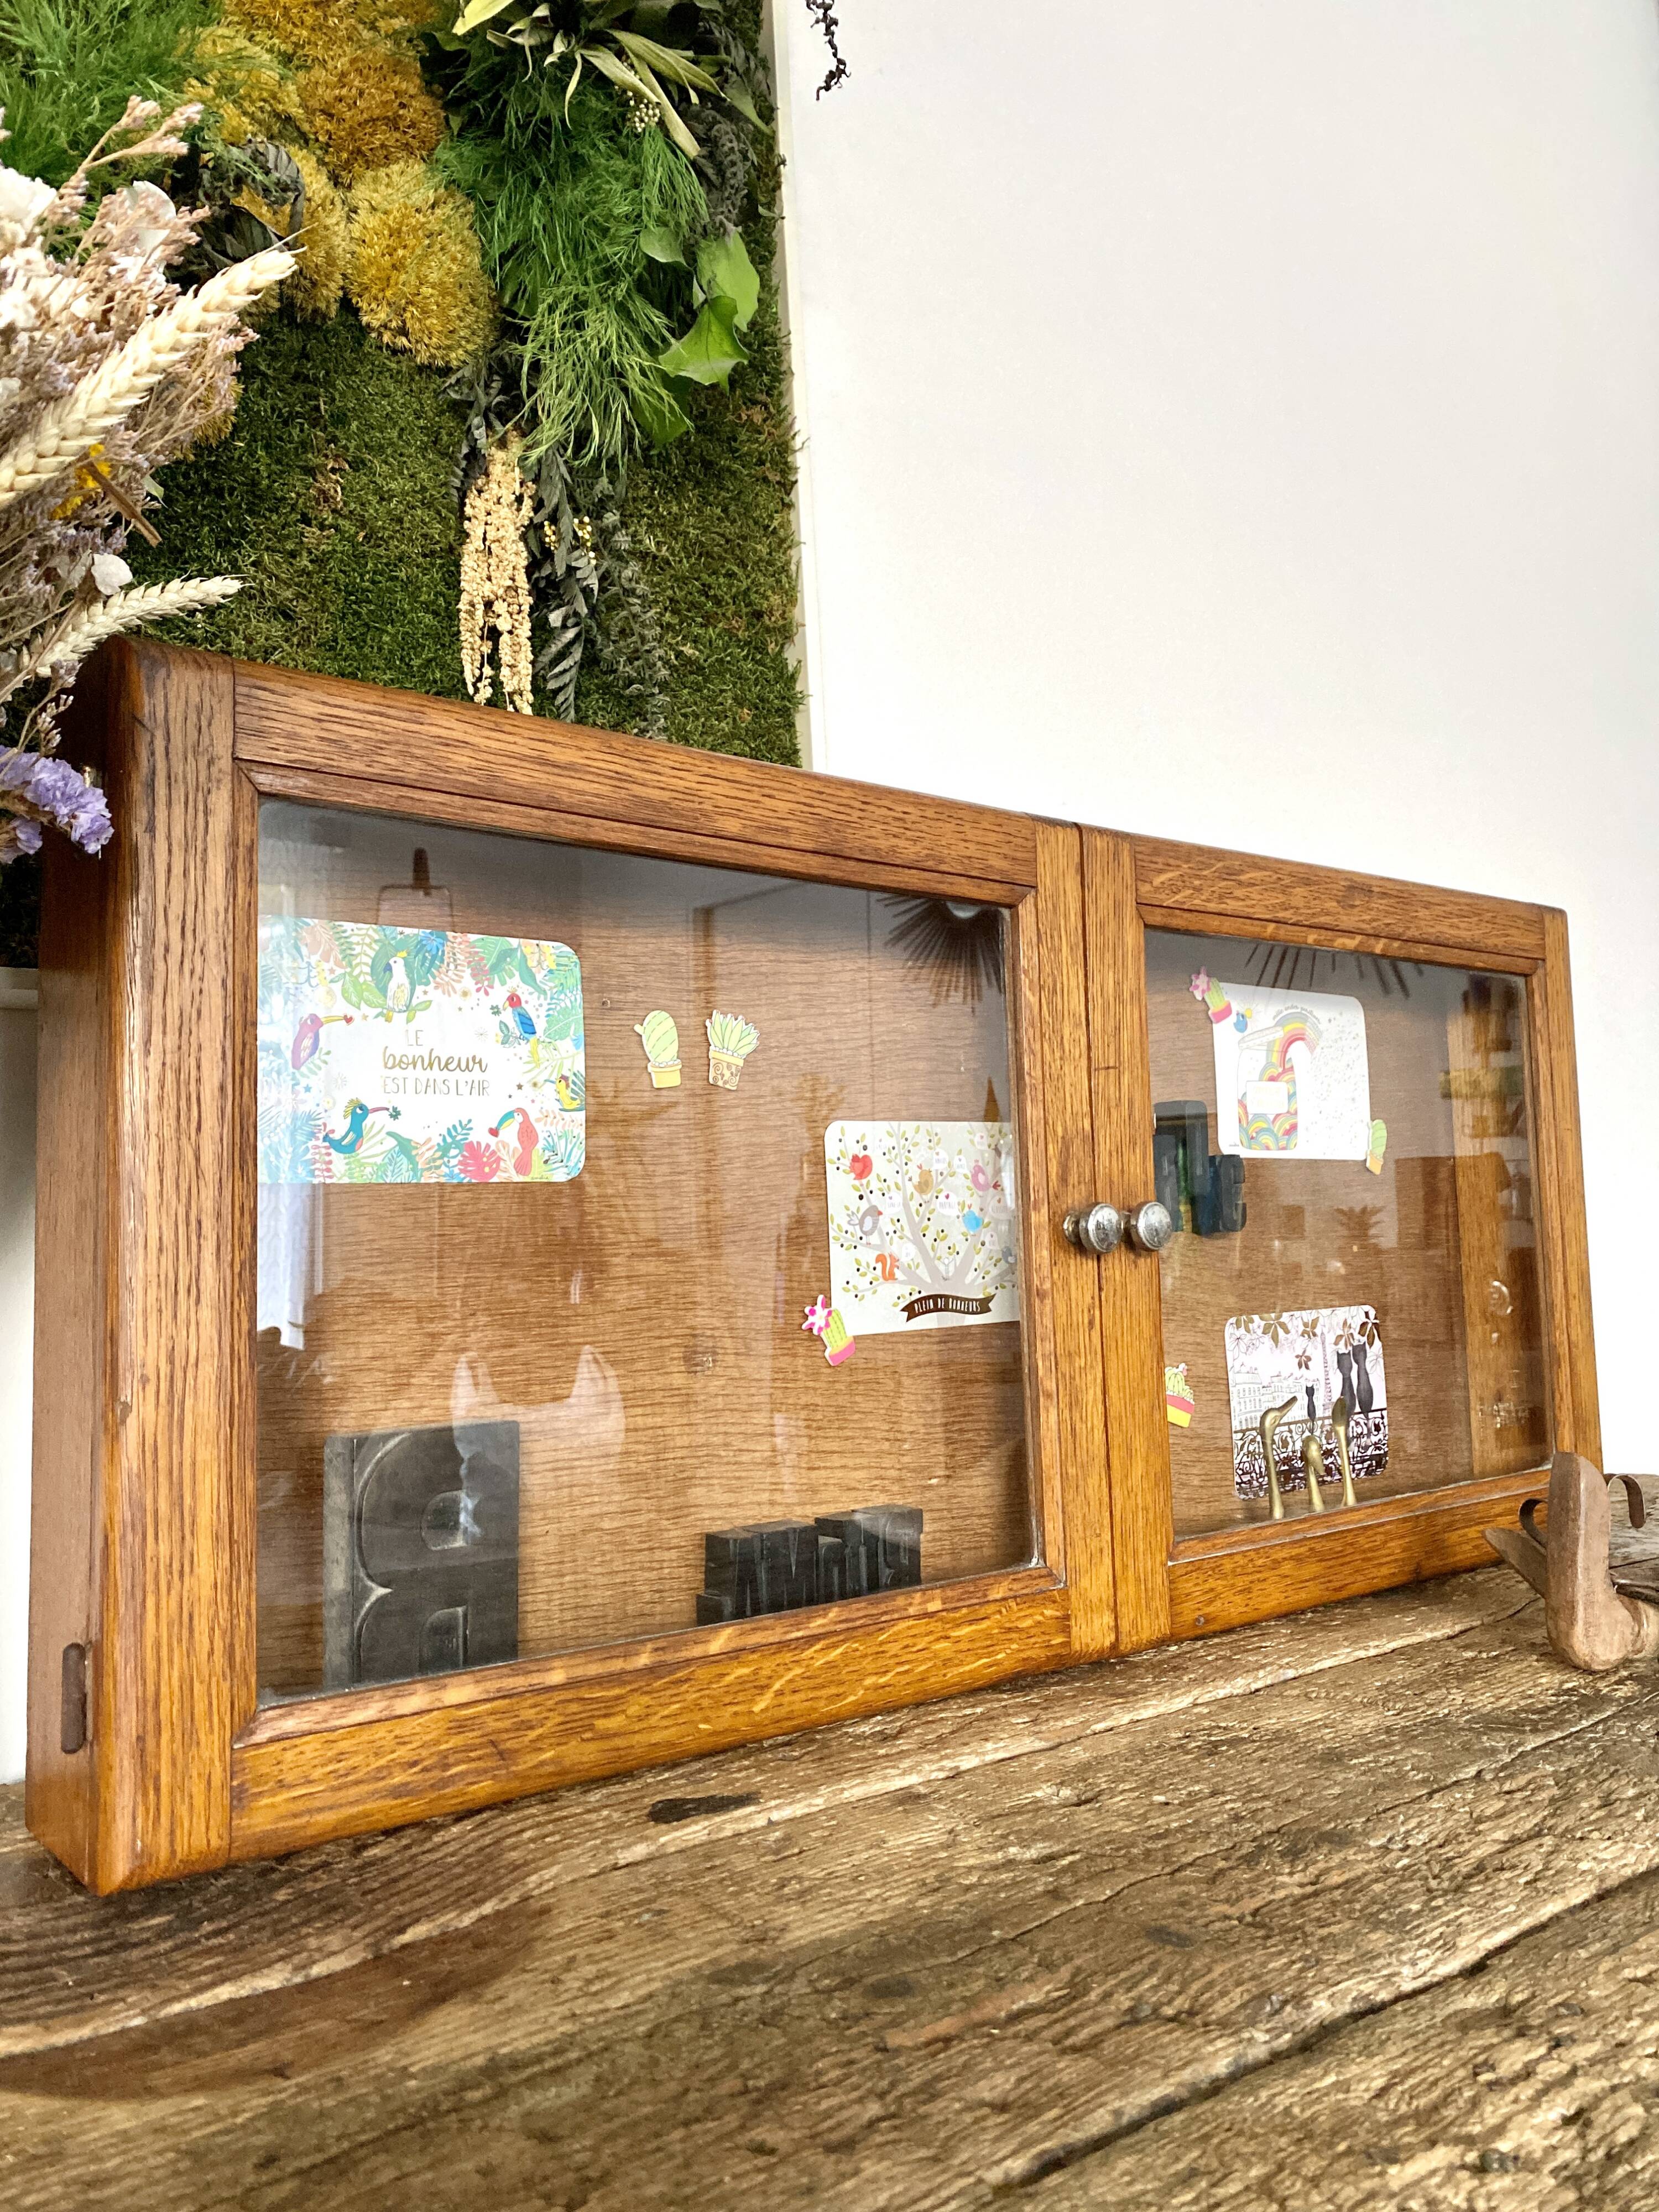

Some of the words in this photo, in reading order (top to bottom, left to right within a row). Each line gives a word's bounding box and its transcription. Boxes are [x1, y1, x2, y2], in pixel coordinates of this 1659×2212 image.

[405, 1029, 424, 1046] LE
[383, 1046, 488, 1073] bonheur
[383, 1076, 408, 1094] EST
[415, 1077, 451, 1095] DANS
[456, 1079, 490, 1097] L'AIR
[914, 1298, 934, 1313] PLEIN
[937, 1297, 945, 1309] DE
